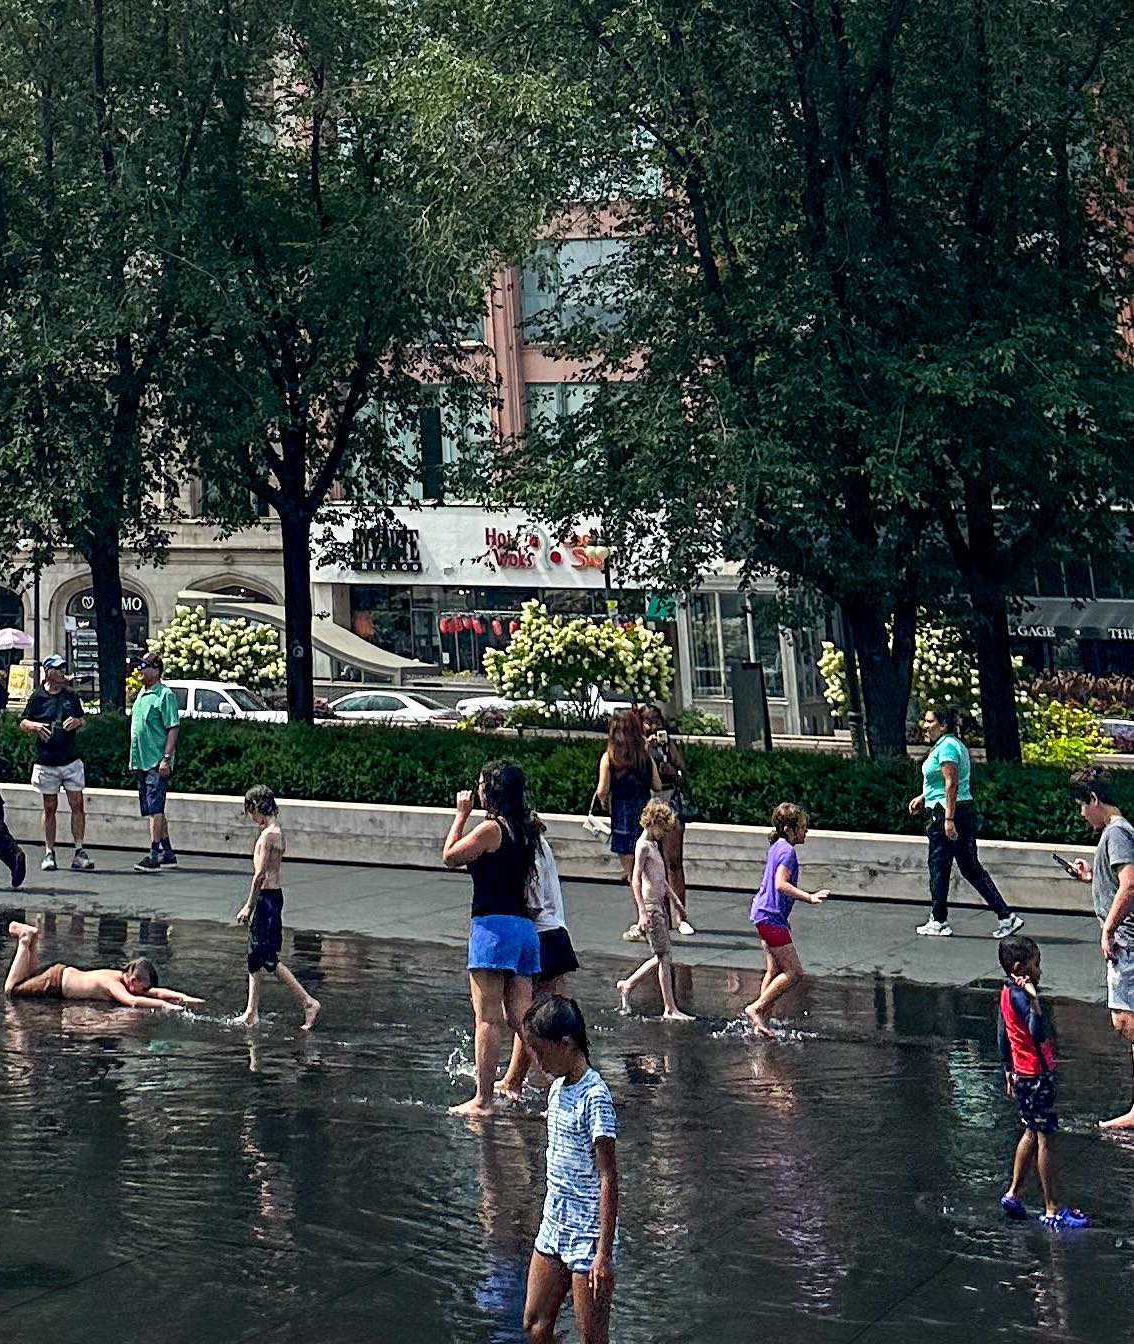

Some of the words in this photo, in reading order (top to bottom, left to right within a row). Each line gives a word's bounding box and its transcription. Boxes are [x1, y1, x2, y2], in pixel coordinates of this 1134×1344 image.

[485, 527, 512, 546] Hot
[492, 547, 535, 567] Woks
[354, 562, 419, 571] HICAGO
[1017, 625, 1056, 638] GAGE
